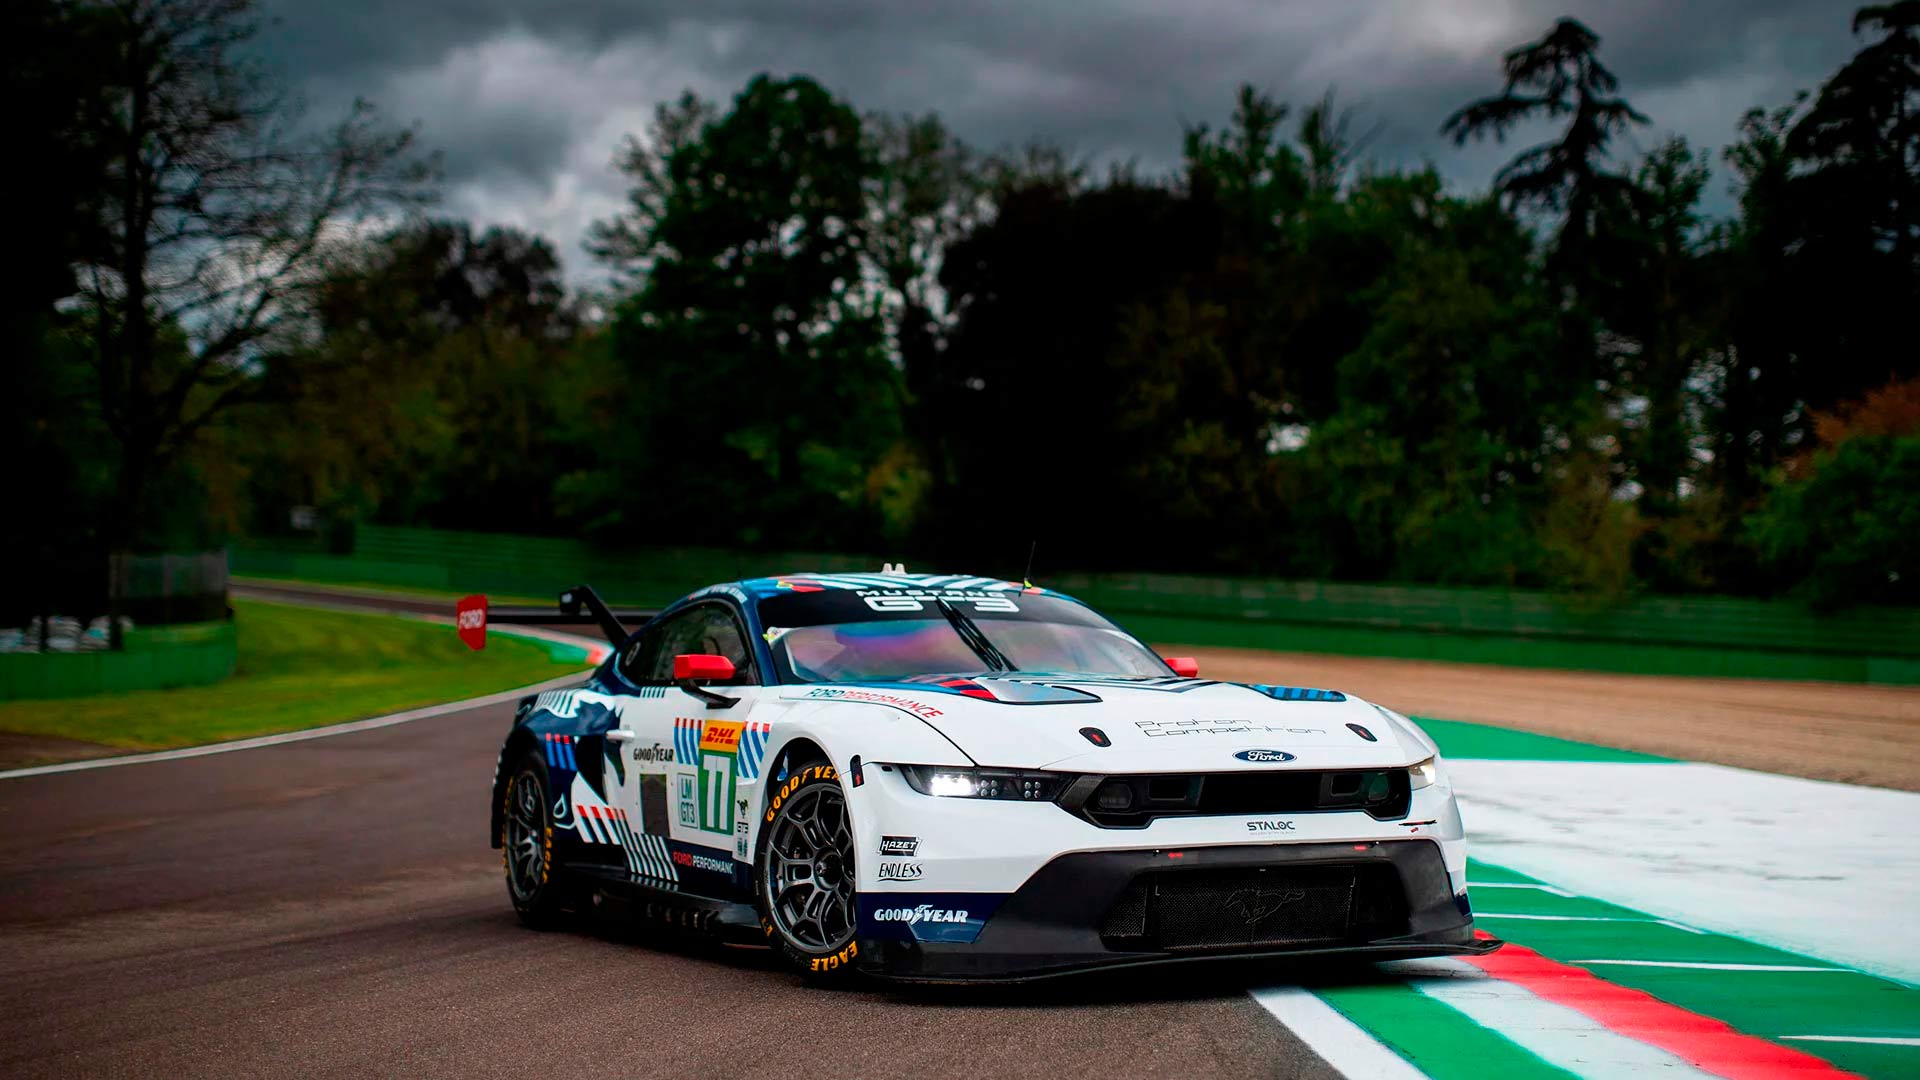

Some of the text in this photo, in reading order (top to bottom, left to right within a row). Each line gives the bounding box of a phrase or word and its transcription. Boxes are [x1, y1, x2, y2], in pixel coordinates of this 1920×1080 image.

[855, 589, 1006, 597] MUSTANG
[863, 595, 1020, 613] GT3
[1134, 718, 1253, 729] Proton
[1143, 725, 1328, 738] Competition
[704, 726, 736, 745] DHL
[633, 744, 675, 763] GOODYEAR
[1247, 750, 1287, 762] Ford
[680, 777, 693, 800] LM
[766, 765, 841, 823] GOODYEA
[680, 801, 696, 824] GT3
[1246, 820, 1296, 831] STALOC
[881, 840, 919, 851] HAZET
[673, 851, 734, 875] FORD PERFORMANC
[878, 862, 924, 878] ENDLESS
[873, 904, 969, 926] GOODYEAR
[809, 940, 858, 972] EAGLE
